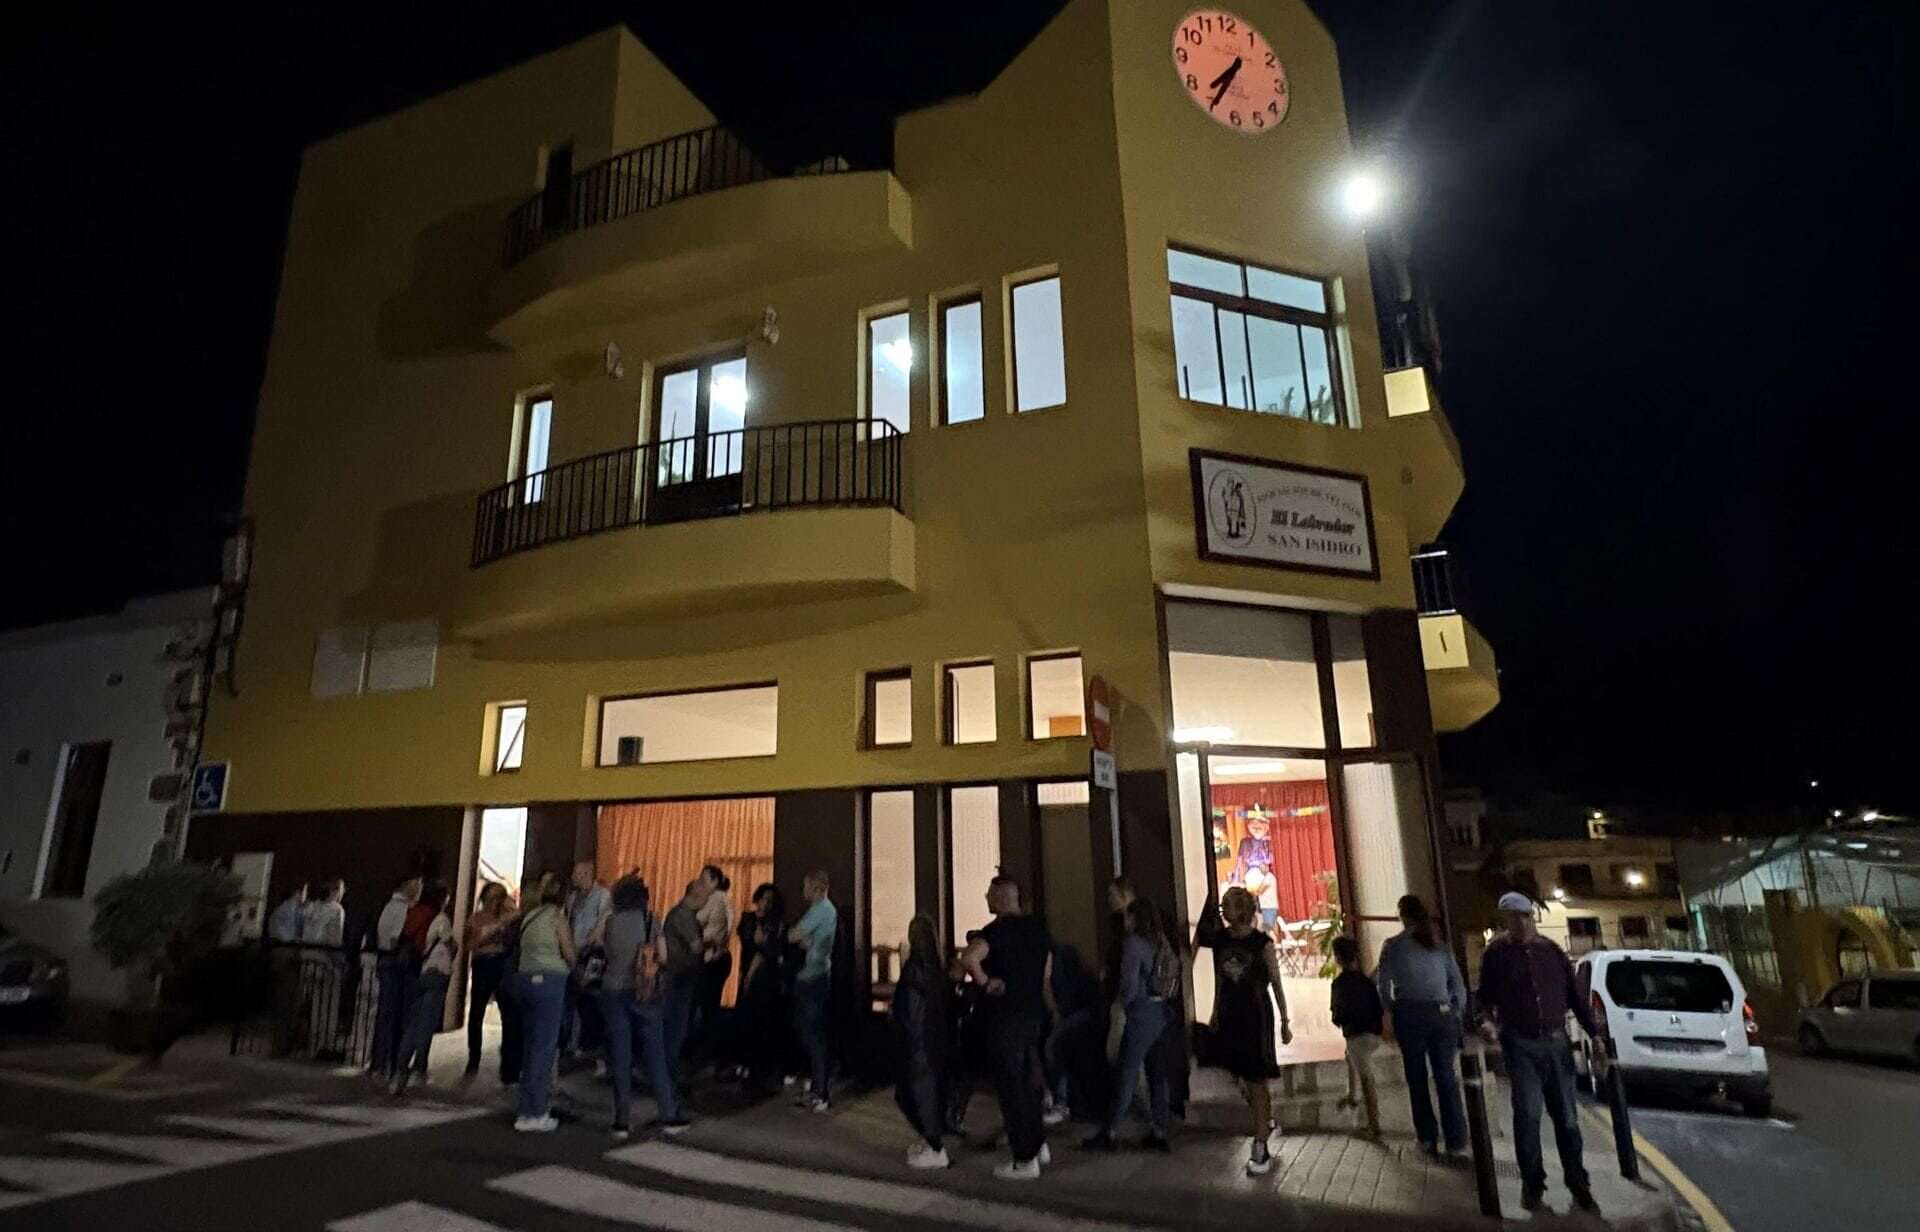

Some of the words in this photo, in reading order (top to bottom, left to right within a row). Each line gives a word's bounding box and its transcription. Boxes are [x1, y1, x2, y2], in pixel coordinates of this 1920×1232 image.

[1197, 16, 1211, 33] 11
[1218, 16, 1237, 35] 12
[1182, 27, 1202, 45] 10
[1248, 32, 1254, 48] 1
[1176, 47, 1188, 64] 9
[1265, 52, 1275, 69] 2
[1186, 74, 1198, 91] 8
[1274, 79, 1285, 95] 3
[1268, 100, 1278, 116] 4
[1230, 111, 1241, 126] 6
[1253, 111, 1264, 127] 5
[1291, 511, 1355, 536] Labrador
[1268, 534, 1300, 549] SAN
[1306, 538, 1362, 556] ISIDRO
